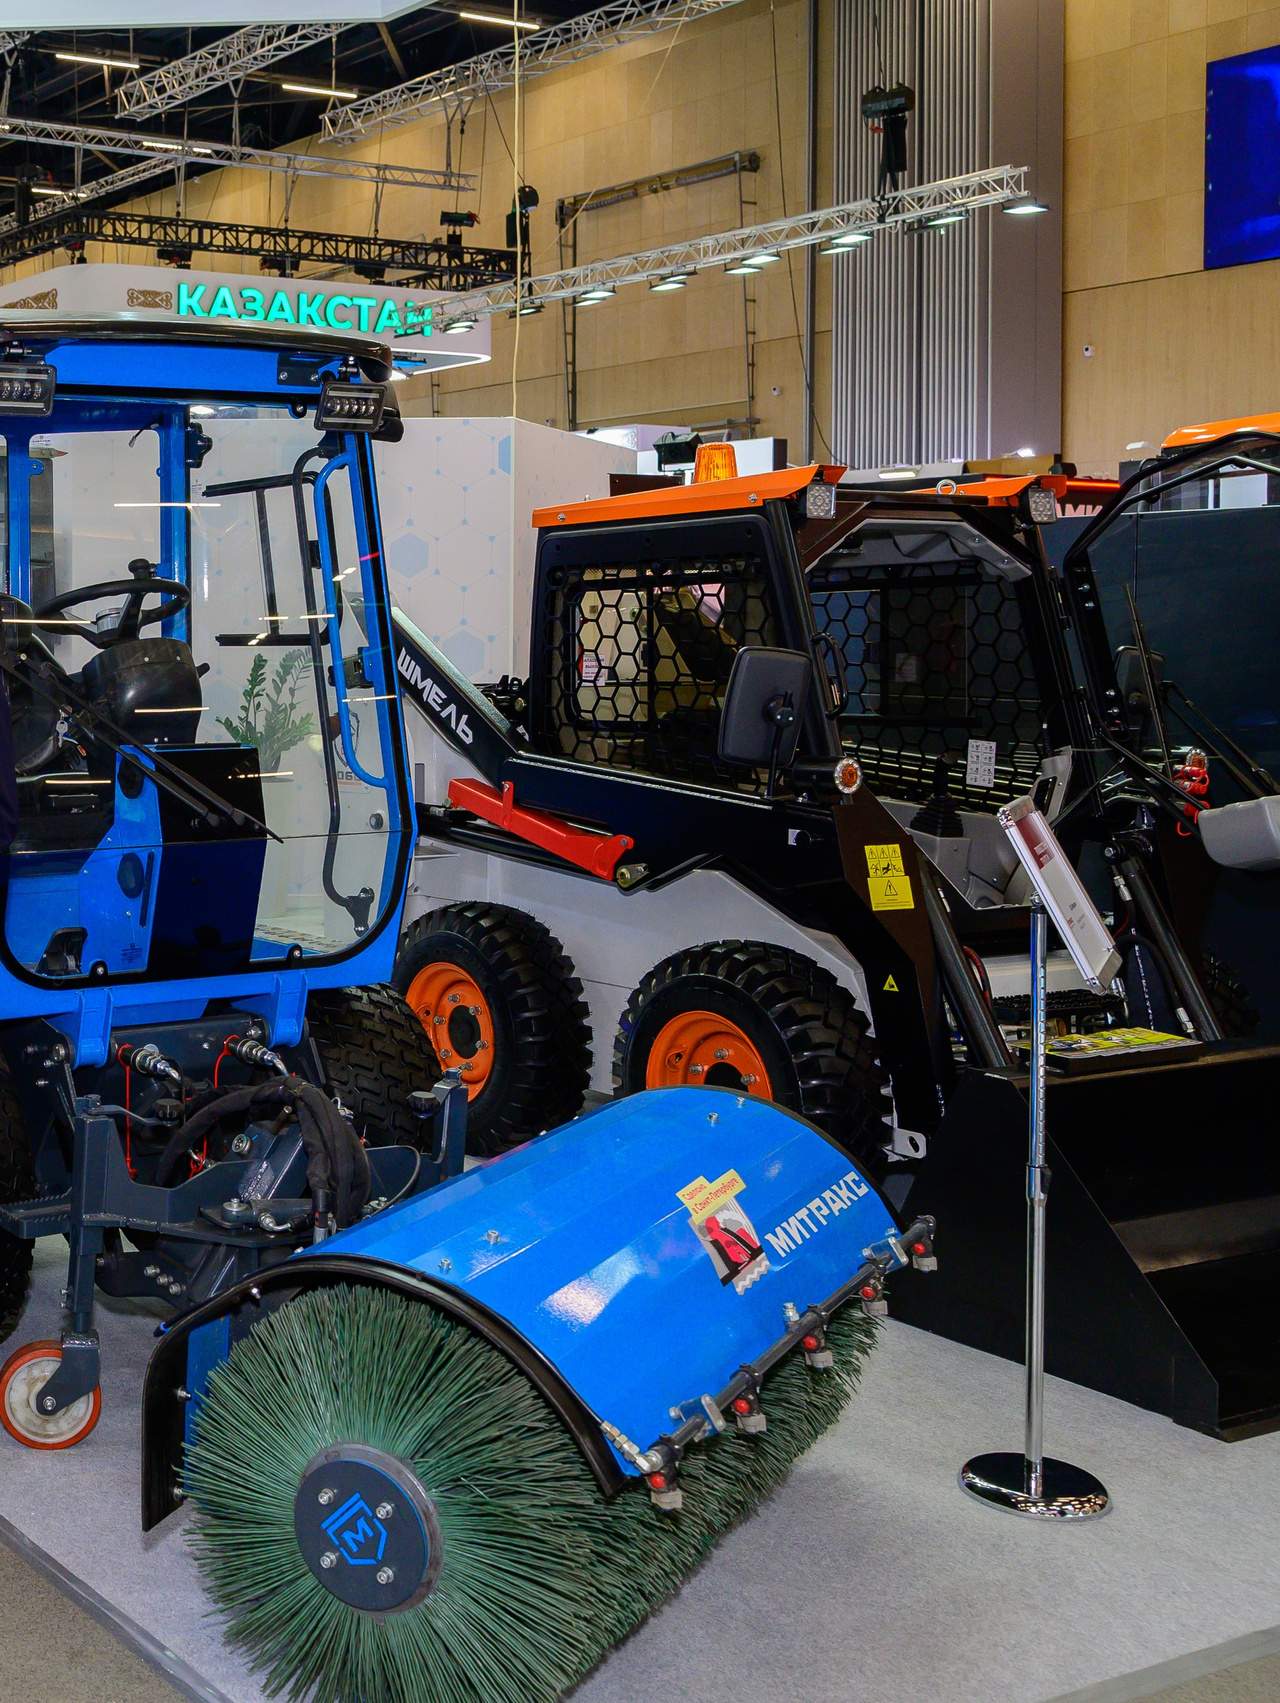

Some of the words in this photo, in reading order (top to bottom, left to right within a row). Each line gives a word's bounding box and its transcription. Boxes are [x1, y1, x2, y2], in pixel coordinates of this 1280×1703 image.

[397, 647, 473, 744] ШМЕЛЬ
[681, 1183, 707, 1201] Сделано
[694, 1177, 739, 1212] Санкт-Петербурге
[764, 1171, 870, 1258] МИТРАКС
